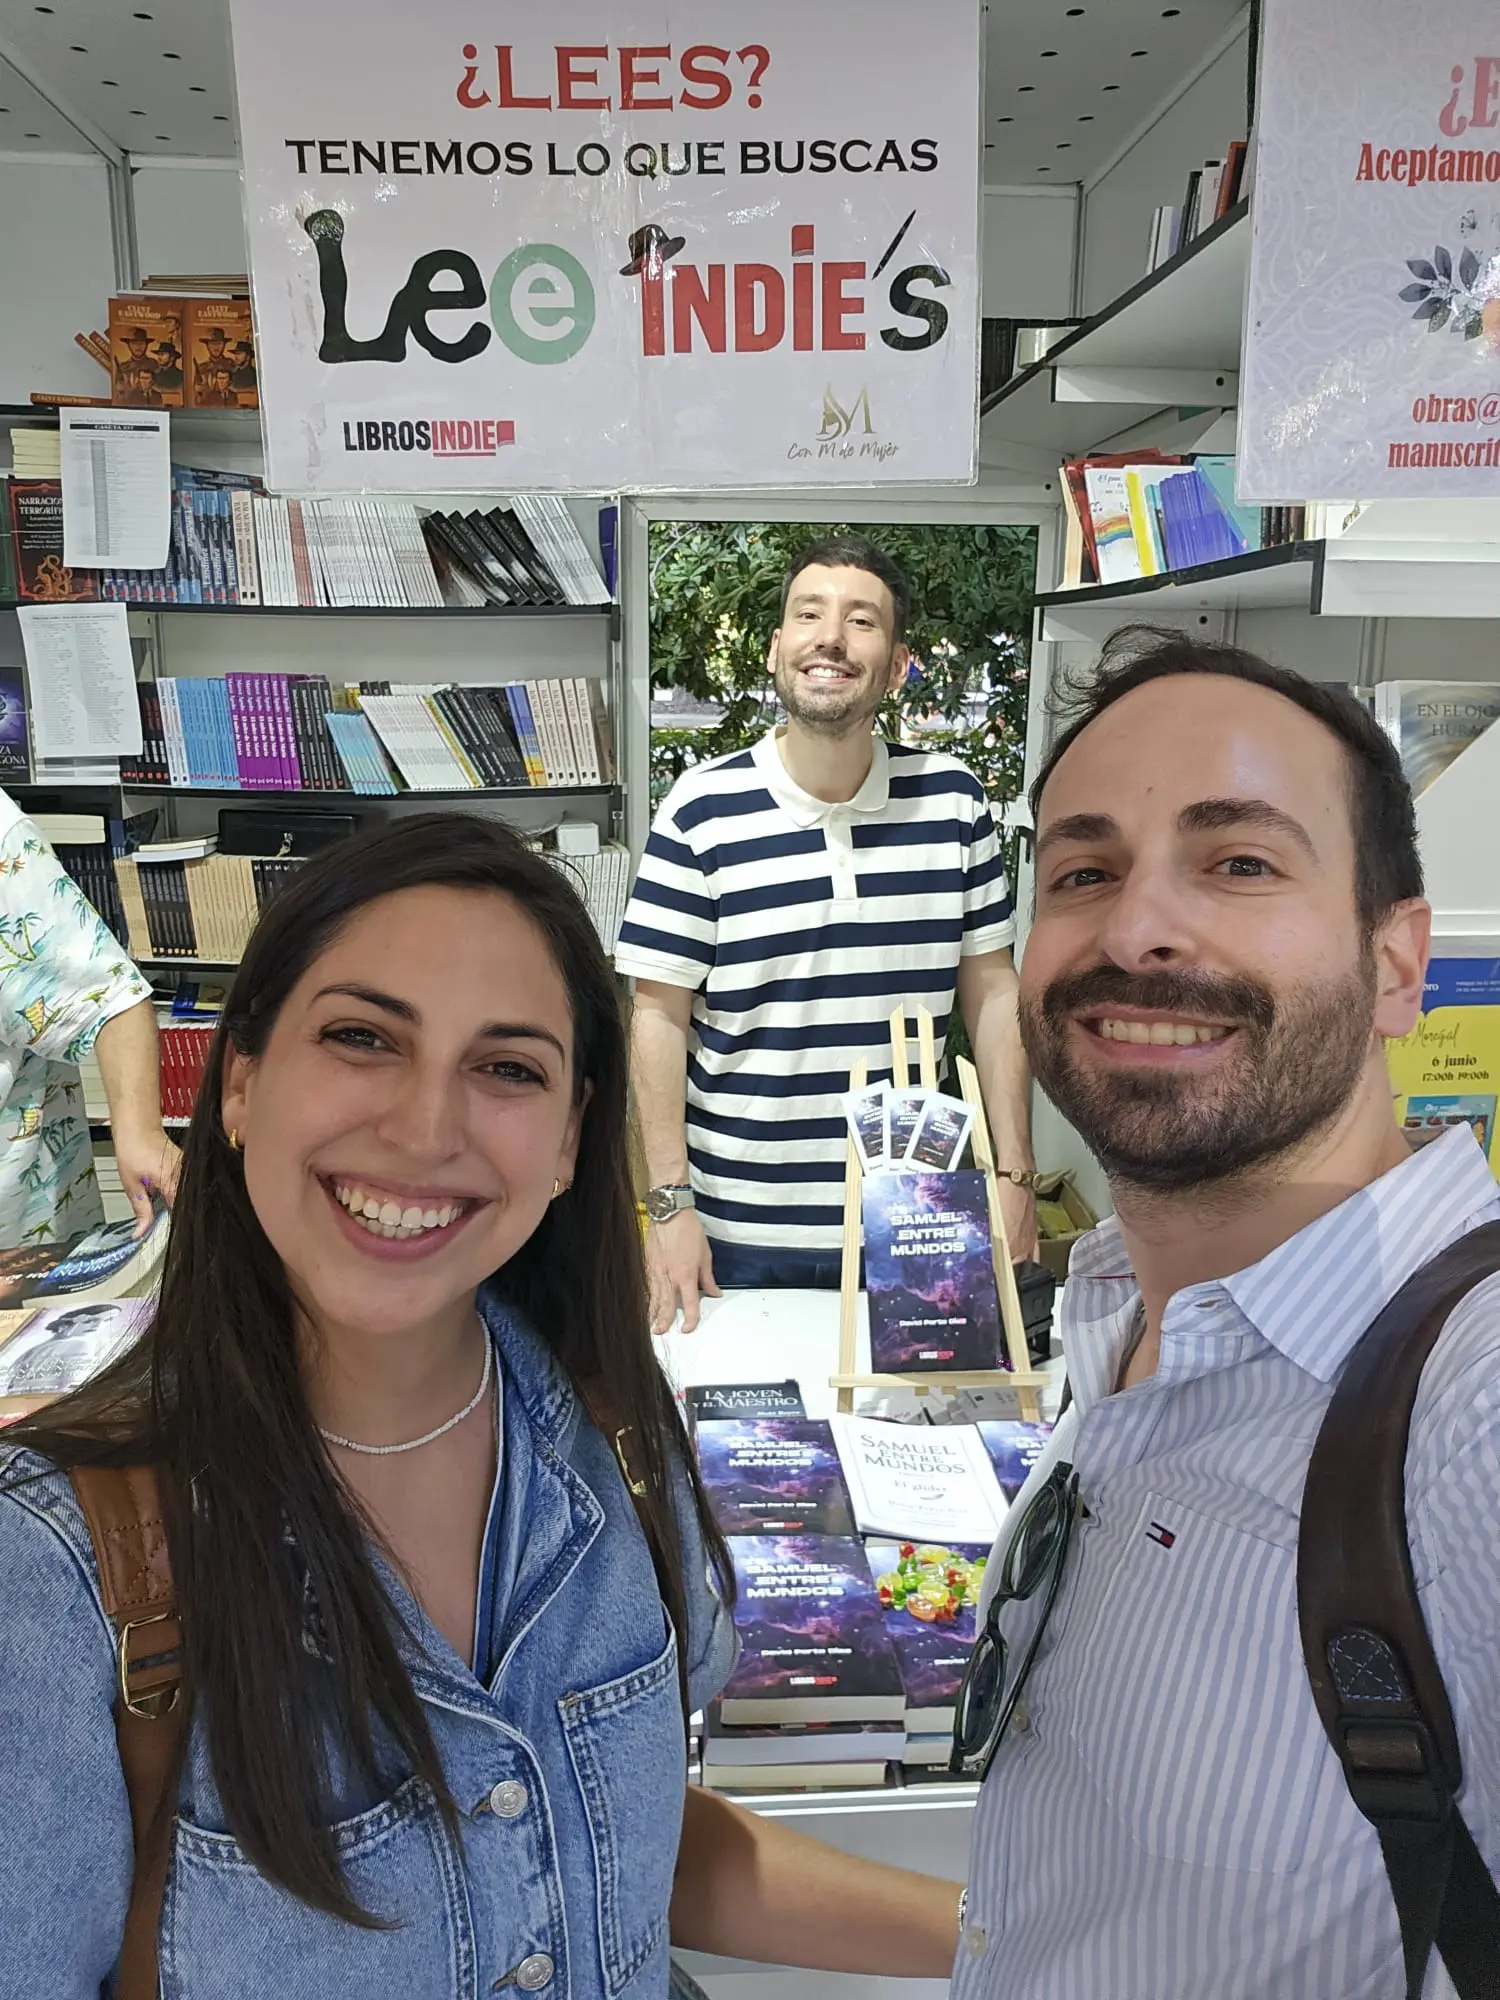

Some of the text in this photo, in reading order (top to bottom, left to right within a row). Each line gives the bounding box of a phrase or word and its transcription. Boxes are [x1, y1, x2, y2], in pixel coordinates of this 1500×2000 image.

[456, 43, 771, 112] ¿LEES?
[285, 139, 939, 181] TENEMOS LO QUE BUSCAS
[787, 442, 812, 459] Con
[818, 442, 836, 458] M
[1417, 704, 1438, 716] EN
[1432, 1054, 1477, 1069] 6 junio
[890, 1212, 962, 1226] SAMUEL
[897, 1227, 957, 1240] ENTRE
[890, 1242, 967, 1256] MUNDOS
[705, 1389, 783, 1400] LA JOVEN
[718, 1397, 799, 1409] MAESTRO
[727, 1440, 808, 1449] SAMUEL
[860, 1434, 957, 1455] SAMUEL
[728, 1458, 813, 1467] MUNDOS
[880, 1449, 944, 1463] ENTRE
[865, 1453, 966, 1473] MUNDOS
[746, 1563, 837, 1574] SAMUEL
[755, 1575, 831, 1585] ENTRE
[746, 1587, 845, 1598] MUNDOS
